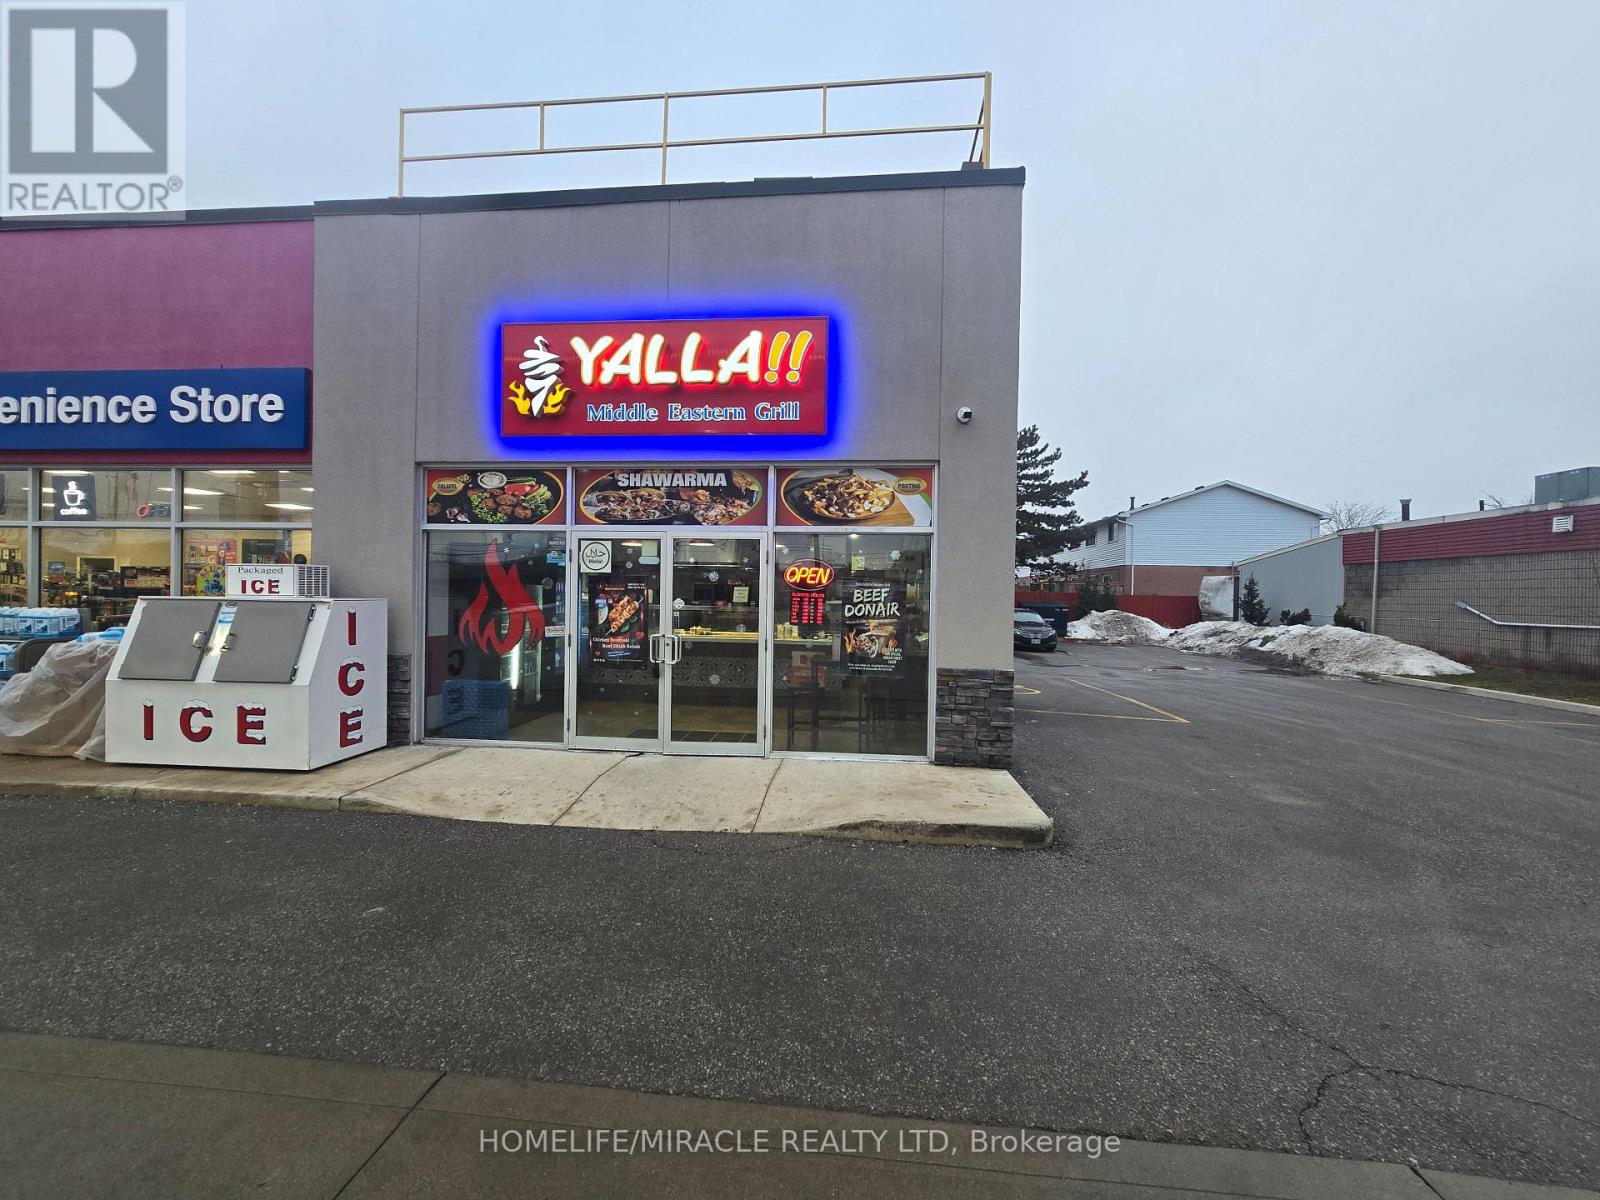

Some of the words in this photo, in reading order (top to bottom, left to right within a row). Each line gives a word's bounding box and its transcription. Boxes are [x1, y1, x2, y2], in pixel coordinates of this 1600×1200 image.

[569, 330, 813, 385] YALLA!!
[169, 385, 285, 424] Store
[586, 402, 659, 422] Middle
[667, 402, 747, 421] Eastern
[754, 401, 801, 421] Grill
[616, 472, 728, 488] SHAWARMA
[59, 507, 88, 516] coffee
[585, 548, 607, 558] حلال
[237, 566, 284, 575] Packaged
[786, 567, 831, 584] OPEN
[241, 579, 281, 594] ICE
[853, 587, 890, 603] BEEF
[844, 602, 901, 617] DONAIR
[338, 607, 366, 748] ICE
[142, 698, 268, 745] ICE
